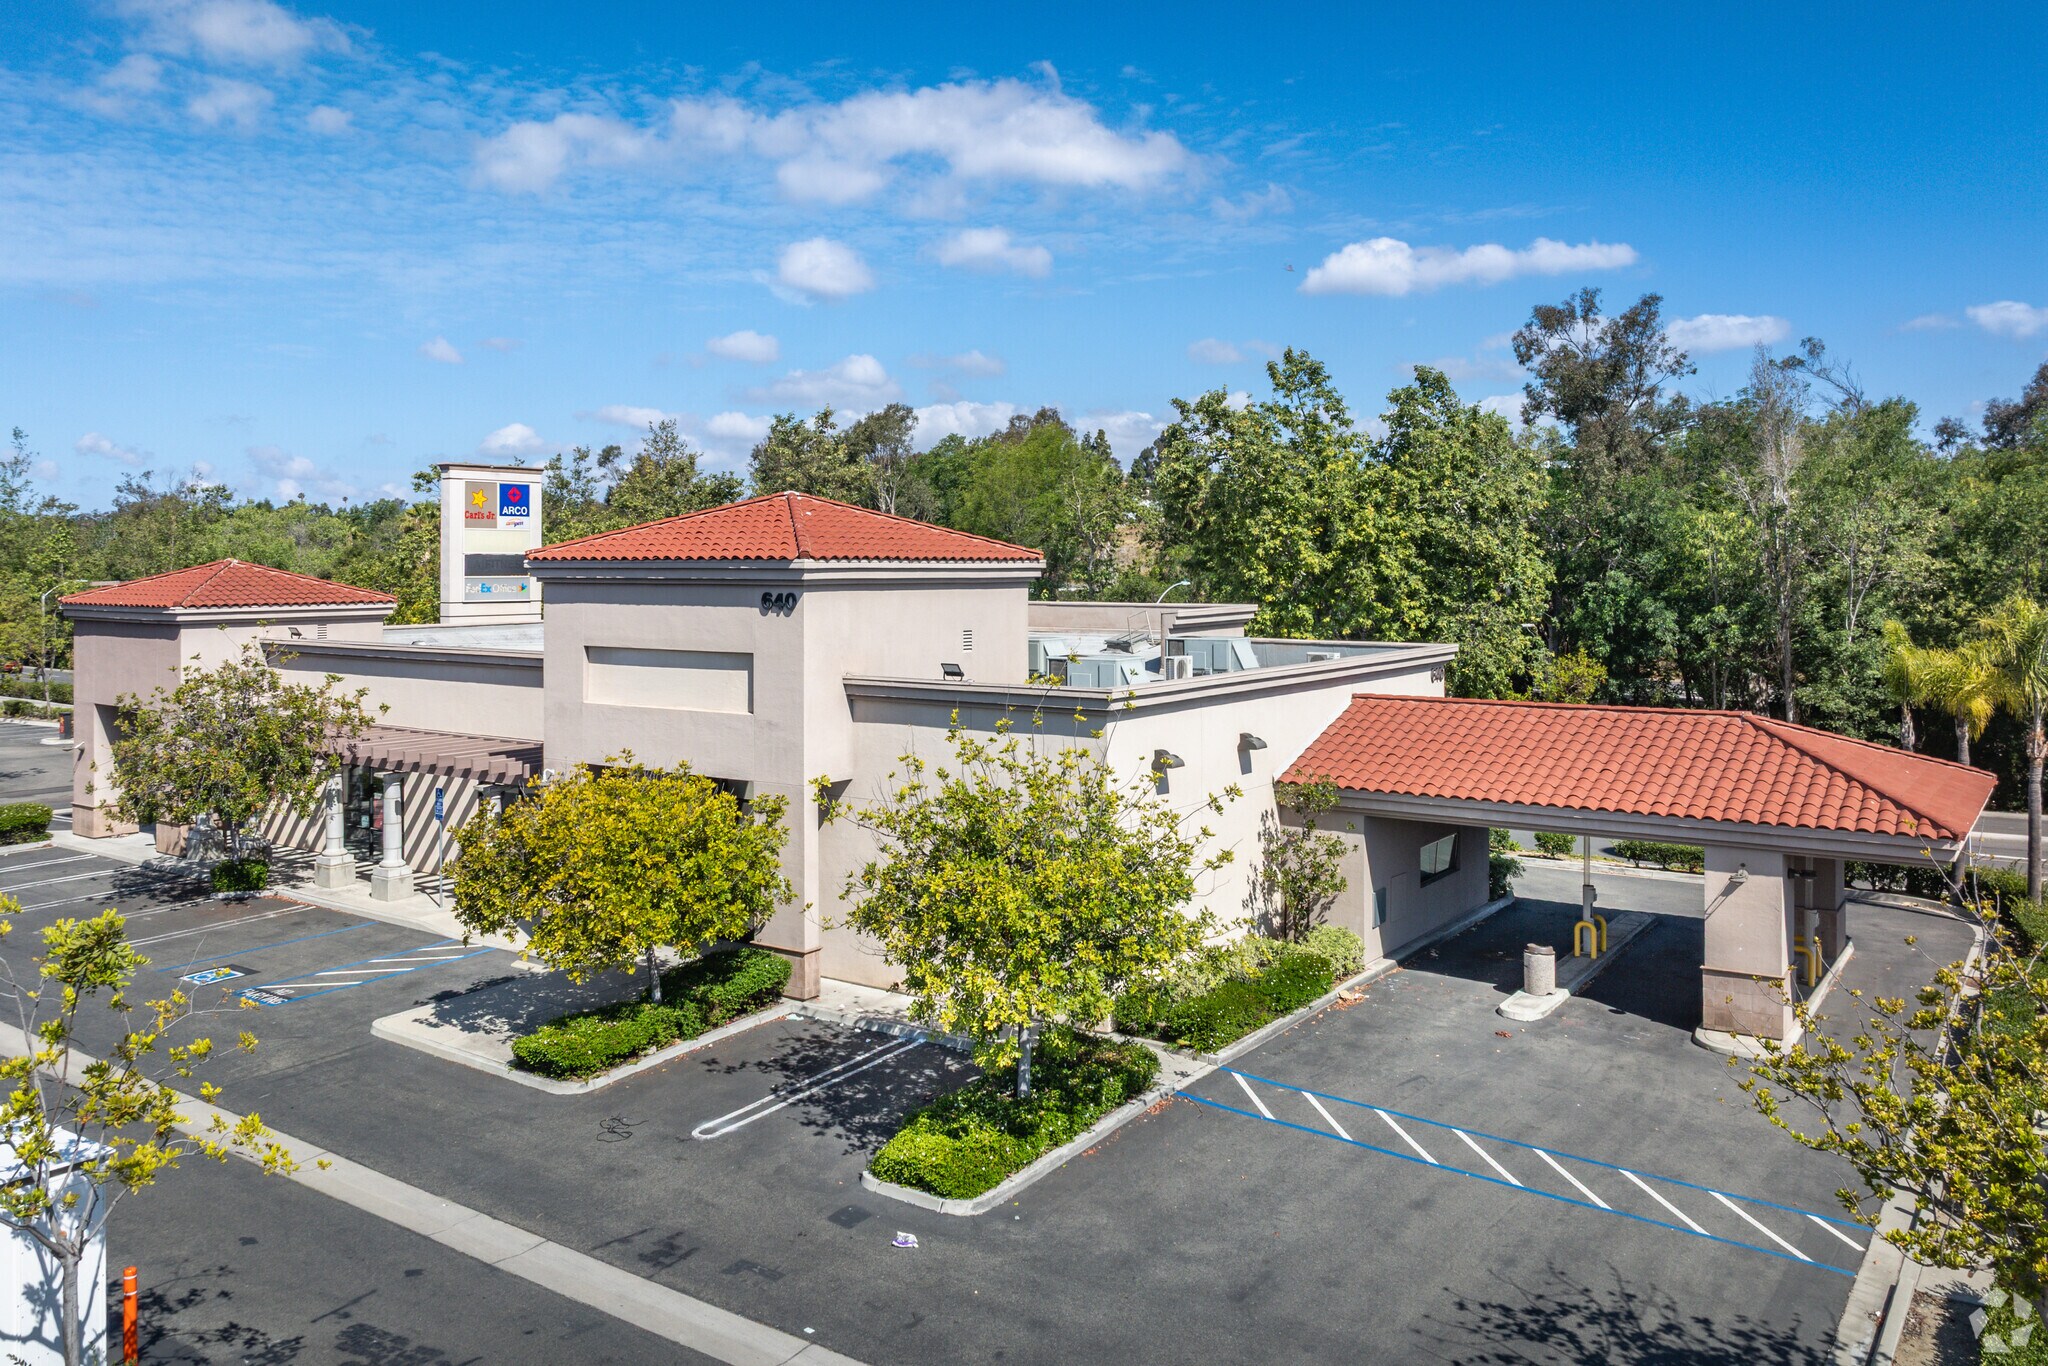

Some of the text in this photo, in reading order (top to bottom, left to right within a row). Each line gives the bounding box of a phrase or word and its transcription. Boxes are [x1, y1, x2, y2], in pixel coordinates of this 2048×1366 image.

[465, 510, 485, 519] Carl's
[502, 506, 528, 515] ARCO
[465, 583, 492, 592] FedEx
[761, 592, 797, 611] 640
